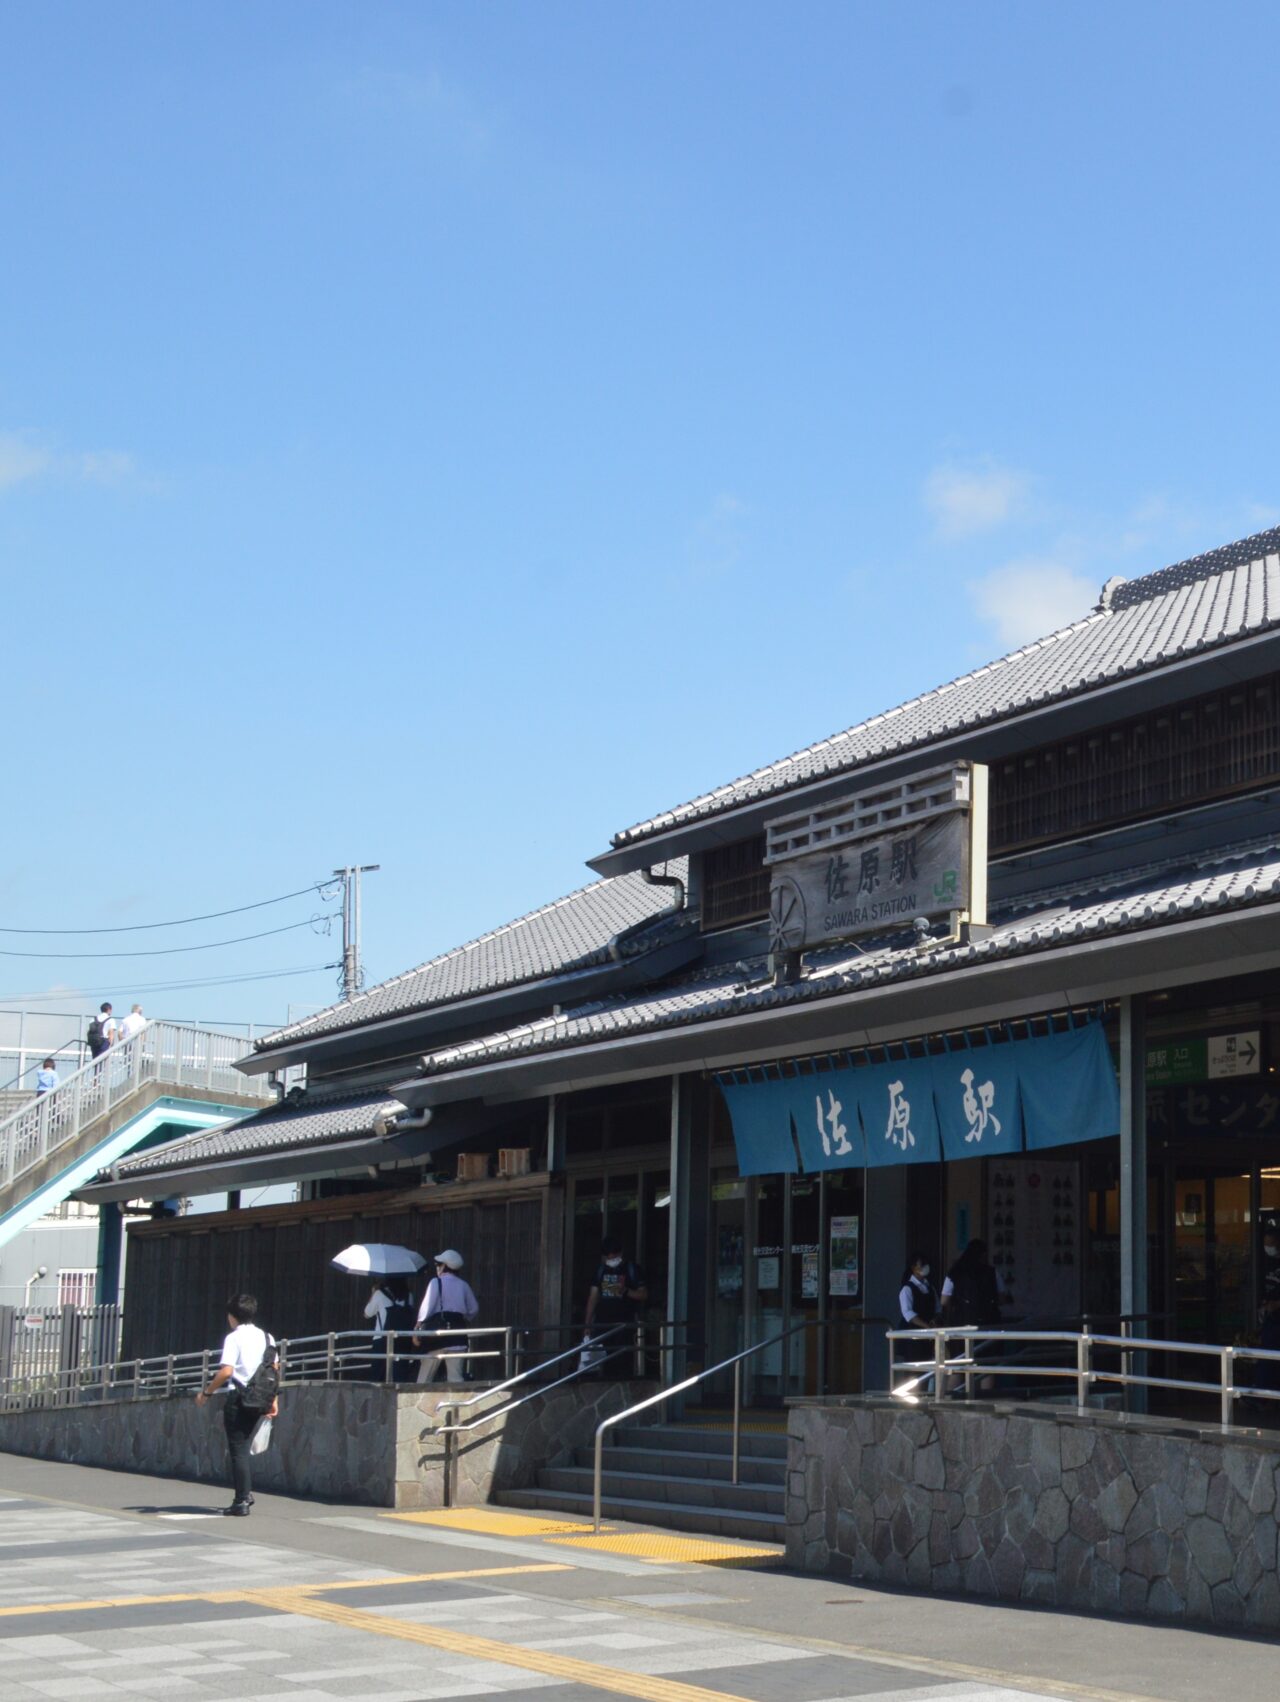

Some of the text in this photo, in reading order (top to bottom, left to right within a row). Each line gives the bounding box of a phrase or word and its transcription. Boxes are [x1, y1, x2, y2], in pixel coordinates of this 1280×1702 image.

[824, 836, 919, 904] 佐原駅
[934, 870, 957, 897] JR
[824, 894, 917, 932] SAWARA STATION
[815, 1068, 1002, 1157] 佐原駅
